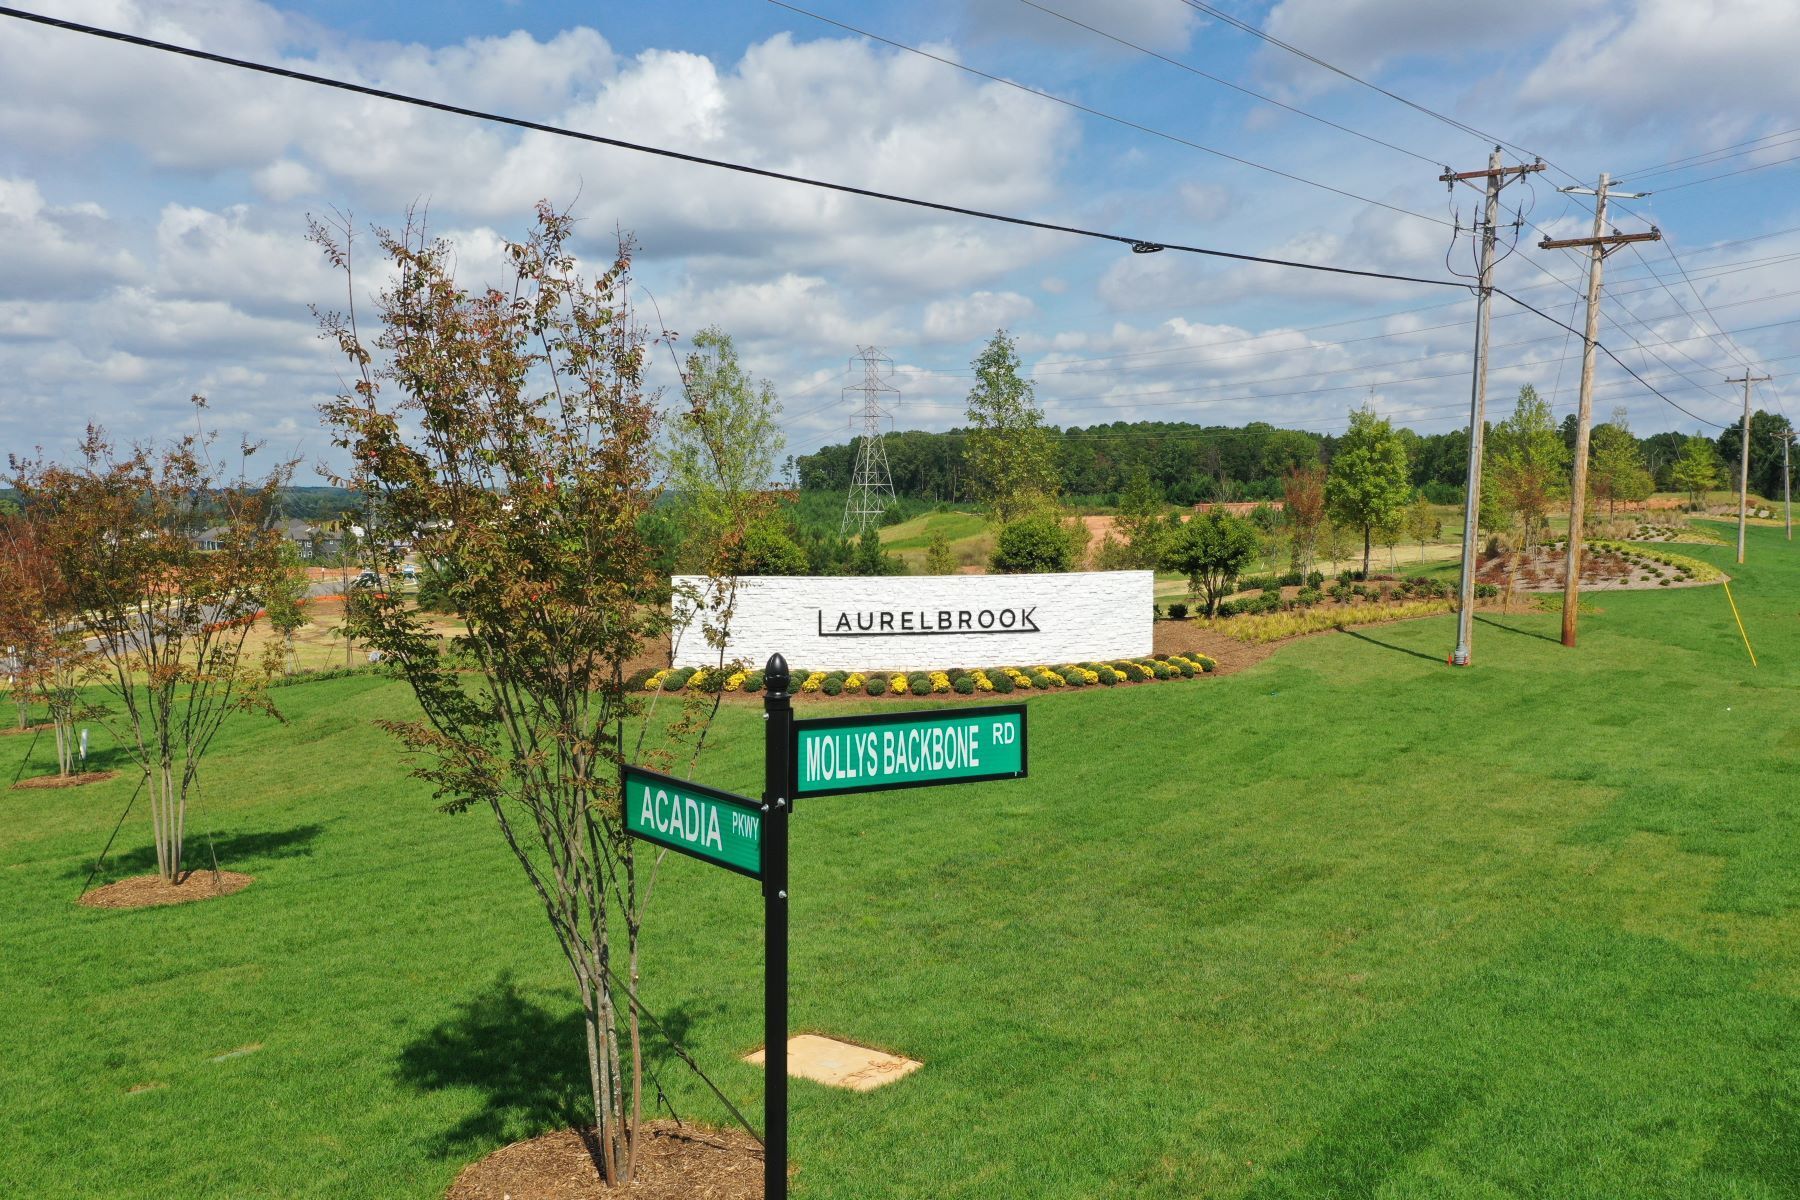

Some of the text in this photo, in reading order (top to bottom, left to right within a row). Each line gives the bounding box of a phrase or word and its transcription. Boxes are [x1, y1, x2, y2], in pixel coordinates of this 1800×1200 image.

[818, 606, 1040, 637] LAURELBROOK
[806, 722, 1015, 782] MOLLYS BACKBONE RD
[640, 786, 759, 852] ACADIA PKWY
